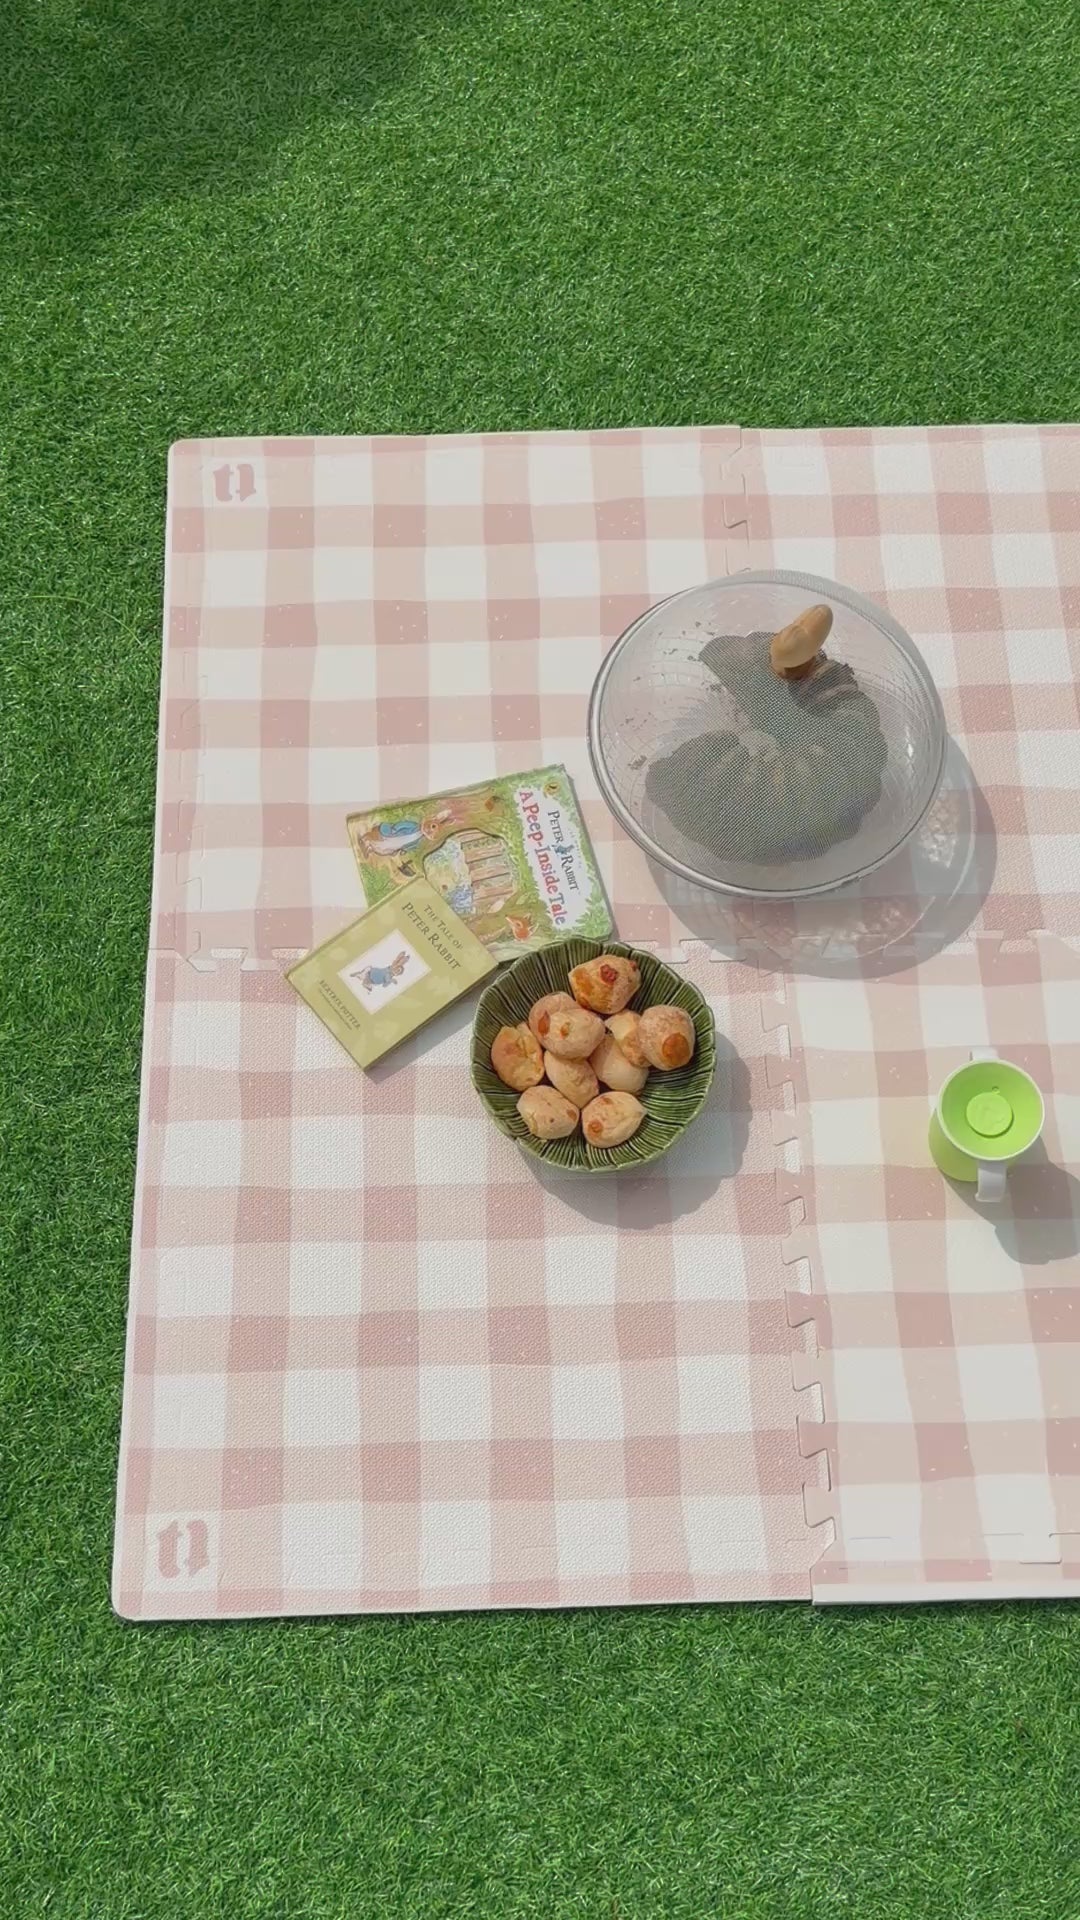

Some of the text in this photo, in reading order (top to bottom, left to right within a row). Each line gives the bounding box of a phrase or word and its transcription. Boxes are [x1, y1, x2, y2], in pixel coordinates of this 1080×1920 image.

[519, 791, 568, 925] A Peep-Inside Tale
[548, 810, 564, 844] PETER
[561, 854, 579, 890] RABBIT
[402, 901, 462, 970] PETER RABBIT
[423, 904, 463, 950] THE TALE OF
